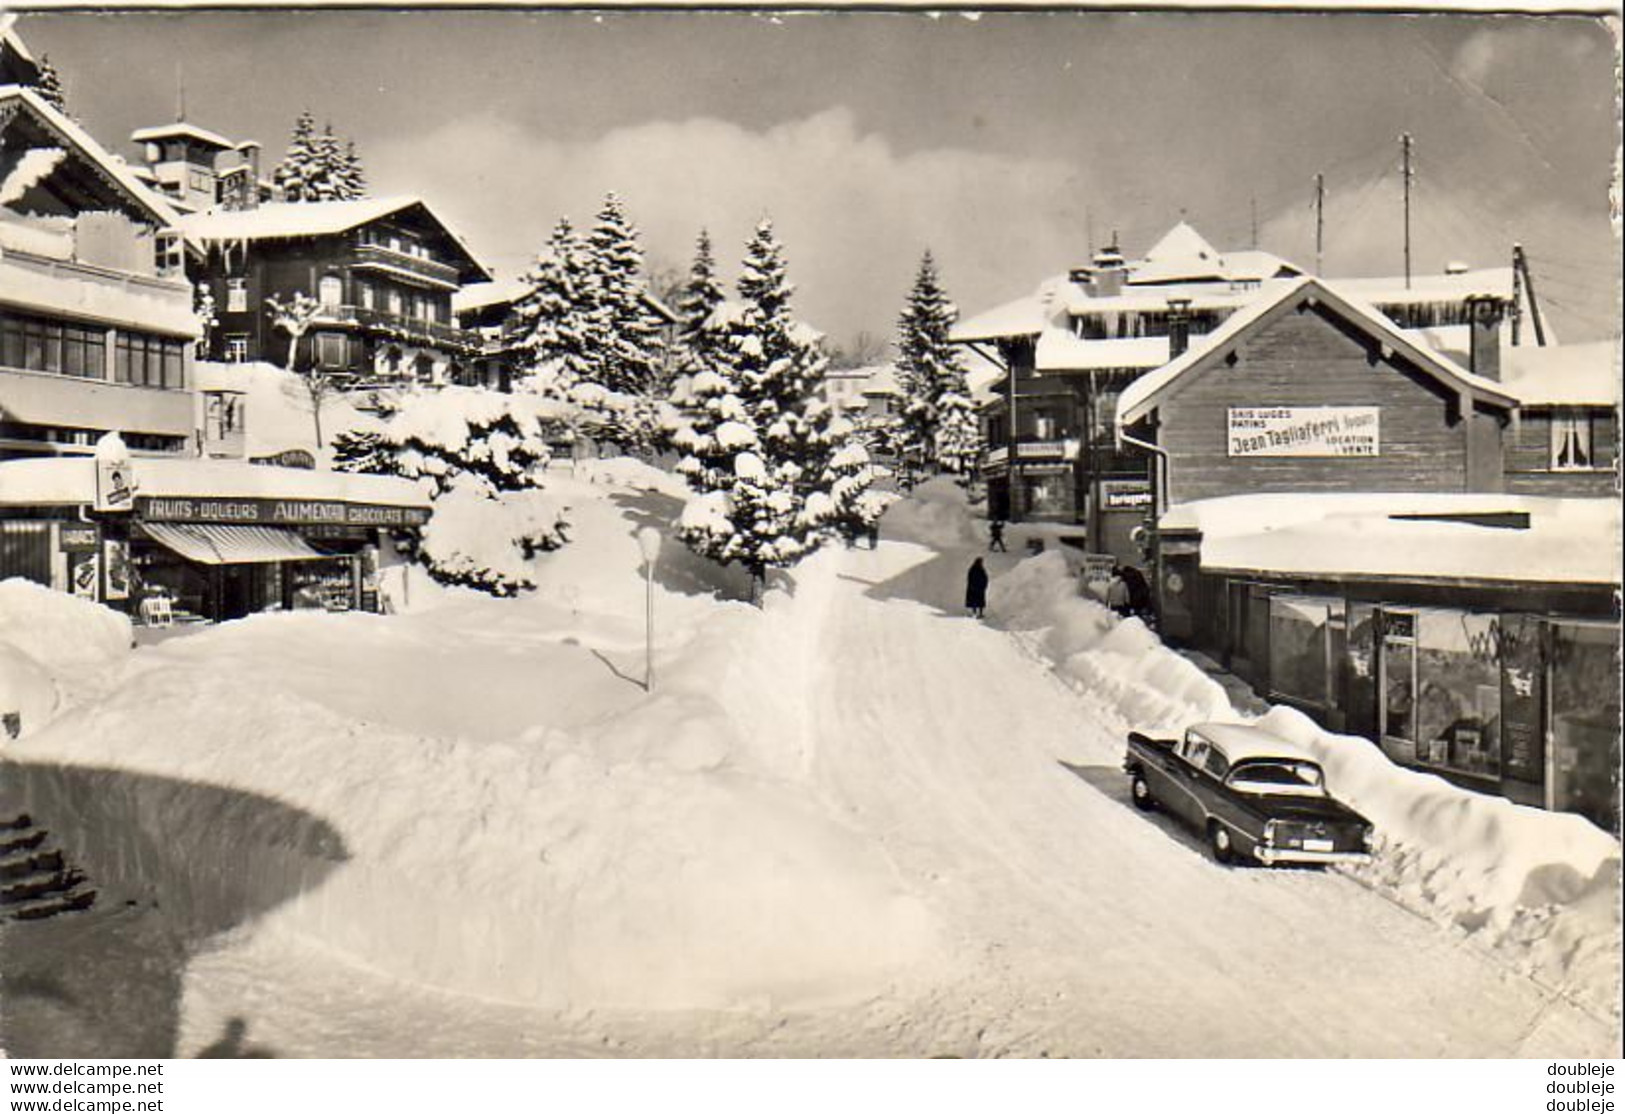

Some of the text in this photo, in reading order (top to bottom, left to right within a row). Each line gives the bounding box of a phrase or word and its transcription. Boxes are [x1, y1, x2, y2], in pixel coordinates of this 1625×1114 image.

[1258, 410, 1292, 419] LUGES
[1231, 419, 1266, 429] PATINS
[1232, 435, 1267, 454] Jean
[1326, 435, 1374, 445] LOCATION
[1342, 445, 1373, 454] VENTE
[149, 500, 192, 518] FRUITS
[201, 502, 258, 520] LIQUEURS
